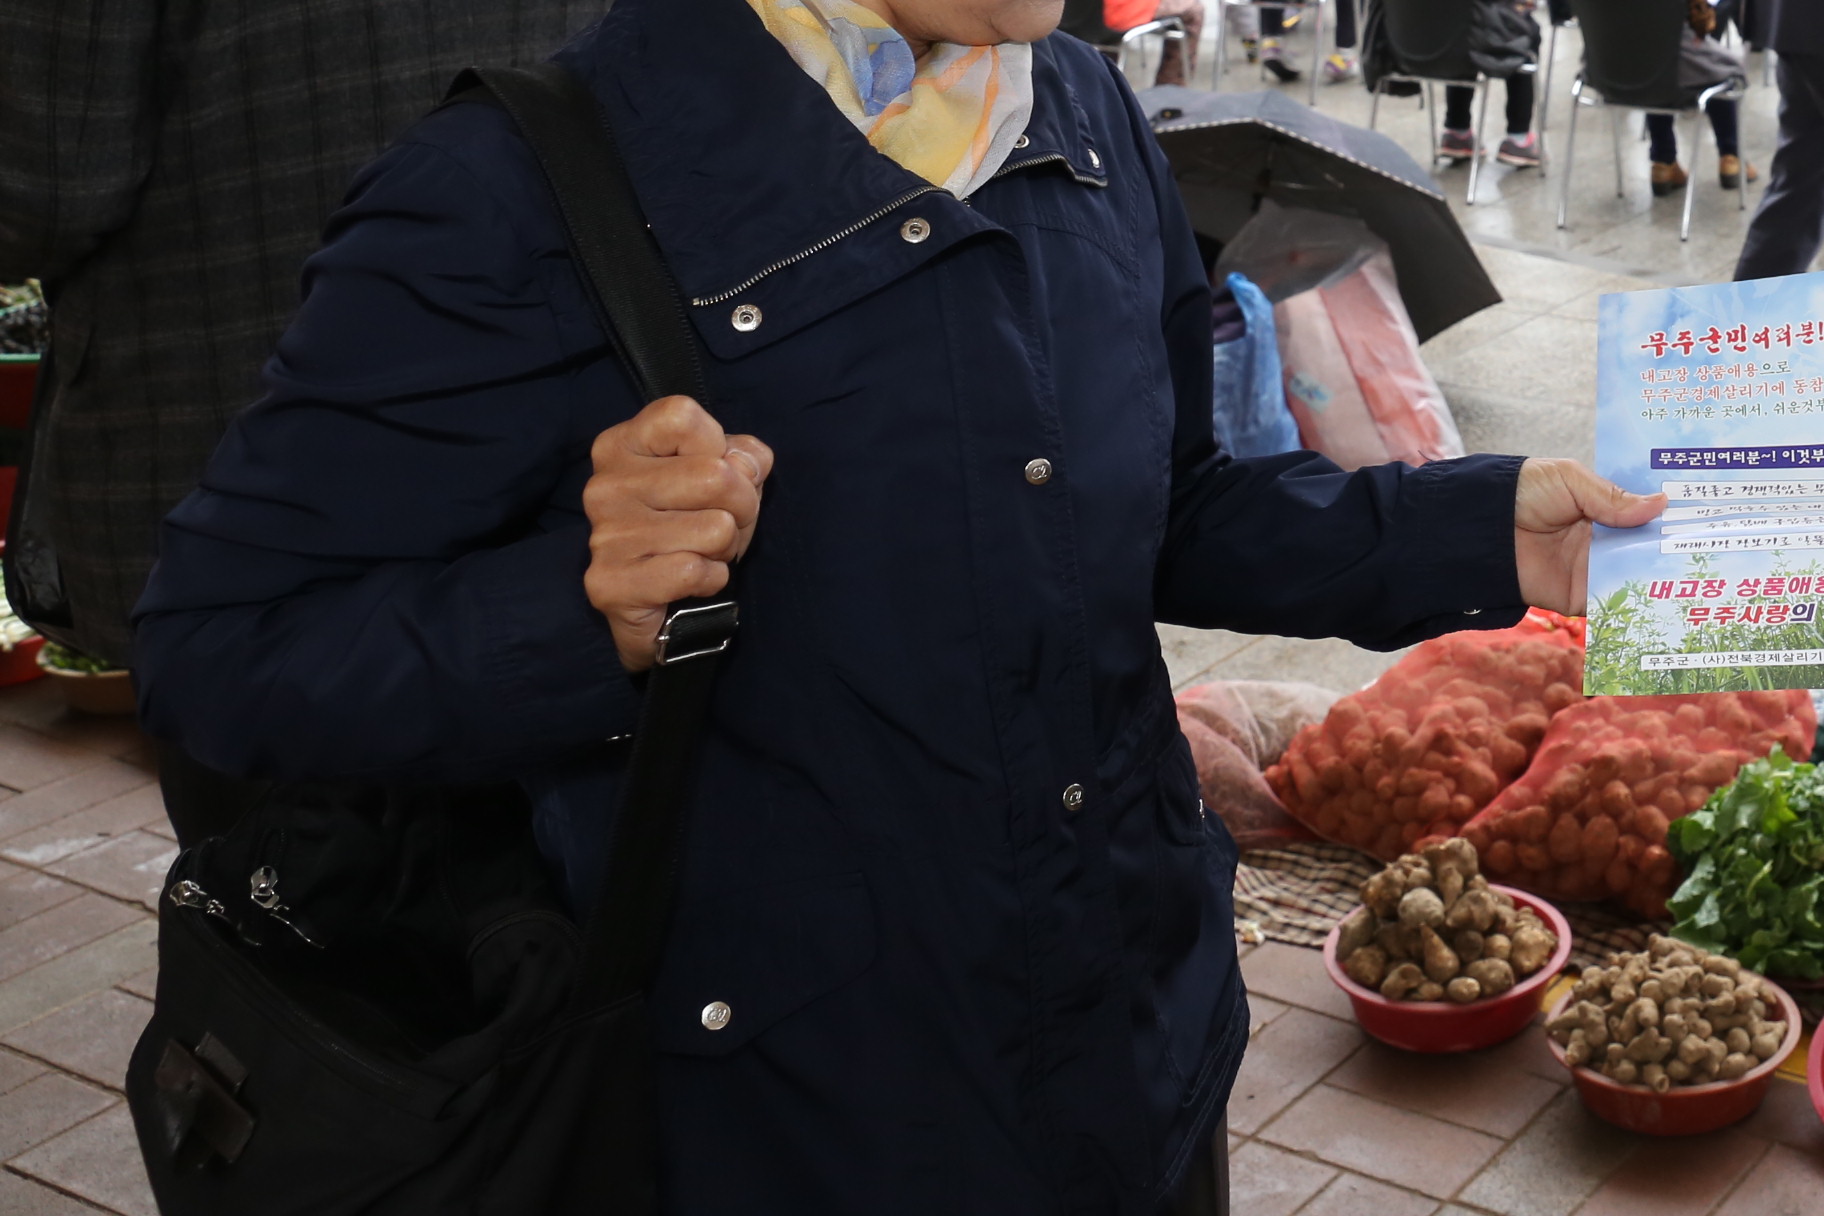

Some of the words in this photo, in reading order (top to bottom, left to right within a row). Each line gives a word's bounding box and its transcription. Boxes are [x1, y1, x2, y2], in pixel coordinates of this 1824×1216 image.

[1641, 367, 1689, 384] 내고장
[1695, 360, 1791, 384] 상품애용으로
[1640, 382, 1786, 404] 무주군경제살리기에
[1641, 406, 1669, 420] 아주
[1673, 405, 1716, 420] 가까운
[1720, 402, 1768, 419] 곳에서,
[1658, 449, 1776, 466] 무주군민여러분~!
[1674, 538, 1730, 549] 재래시장
[1736, 536, 1792, 548] 장보기로
[1648, 579, 1727, 600] 내고장
[1686, 603, 1814, 627] 무주사랑의
[1648, 655, 1690, 667] 무주군
